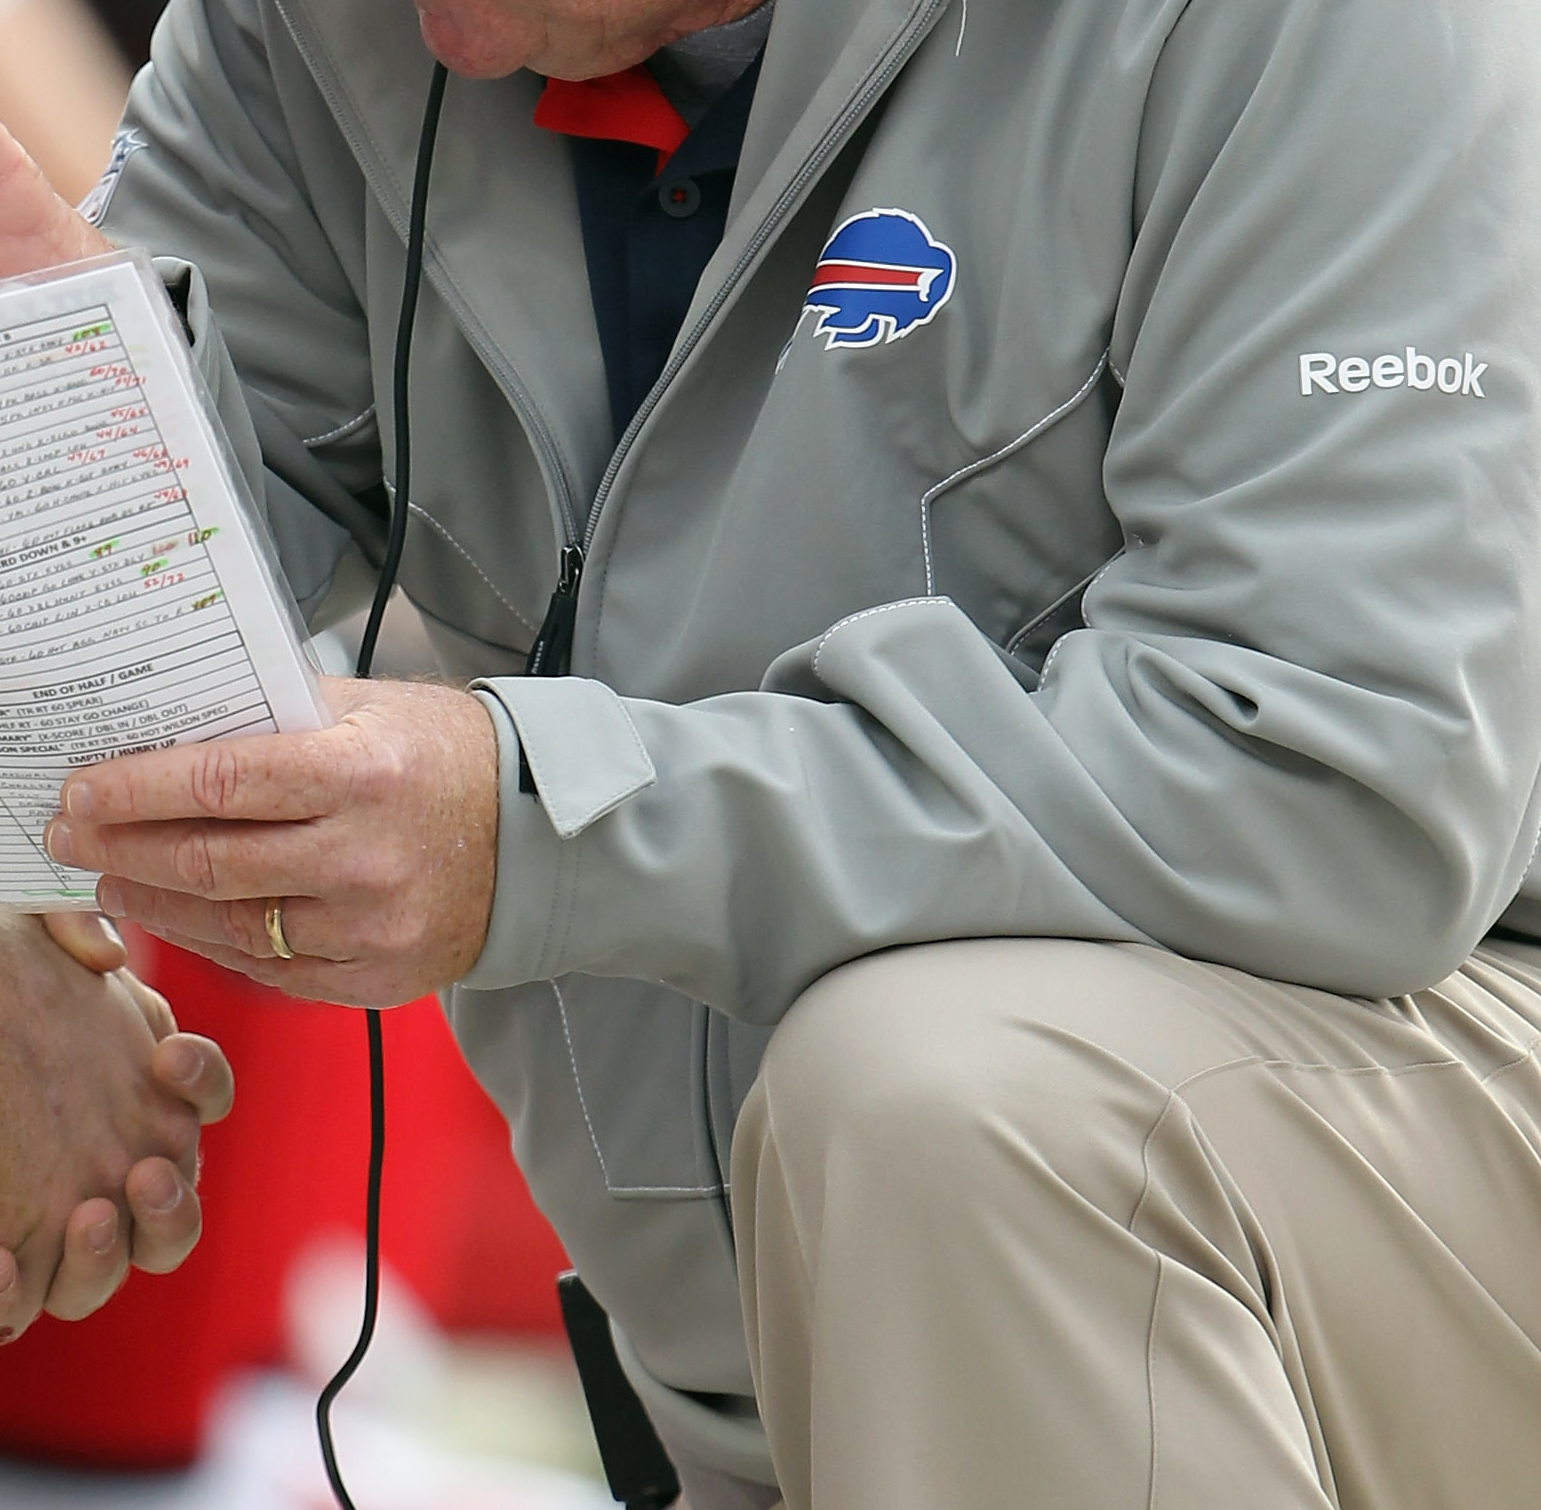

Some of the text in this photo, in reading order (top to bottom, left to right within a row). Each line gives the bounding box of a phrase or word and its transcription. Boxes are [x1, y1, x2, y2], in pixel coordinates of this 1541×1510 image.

[1299, 346, 1489, 398] Reebok
[19, 544, 58, 563] DOWN
[61, 540, 72, 550] &
[143, 572, 185, 589] 52/72
[32, 688, 58, 699] END
[60, 685, 75, 696] OF
[78, 676, 107, 691] HALF
[118, 662, 155, 680] GAME
[40, 719, 54, 728] 60
[55, 714, 80, 726] STAY
[82, 709, 100, 720] GO
[101, 698, 150, 717] CHANGE)
[51, 703, 65, 713] 60
[66, 697, 104, 712] SPEAR)
[95, 722, 116, 734] DBL
[117, 720, 130, 729] IN
[139, 713, 159, 725] DBL
[160, 703, 189, 719] OUT)
[101, 736, 119, 746] STR
[127, 731, 140, 741] 60
[140, 726, 161, 738] HOT
[162, 714, 200, 733] WILSON
[201, 704, 229, 721] SPEC)
[67, 751, 107, 765] EMPTY
[118, 743, 158, 757] HURRY
[160, 738, 177, 750] UP
